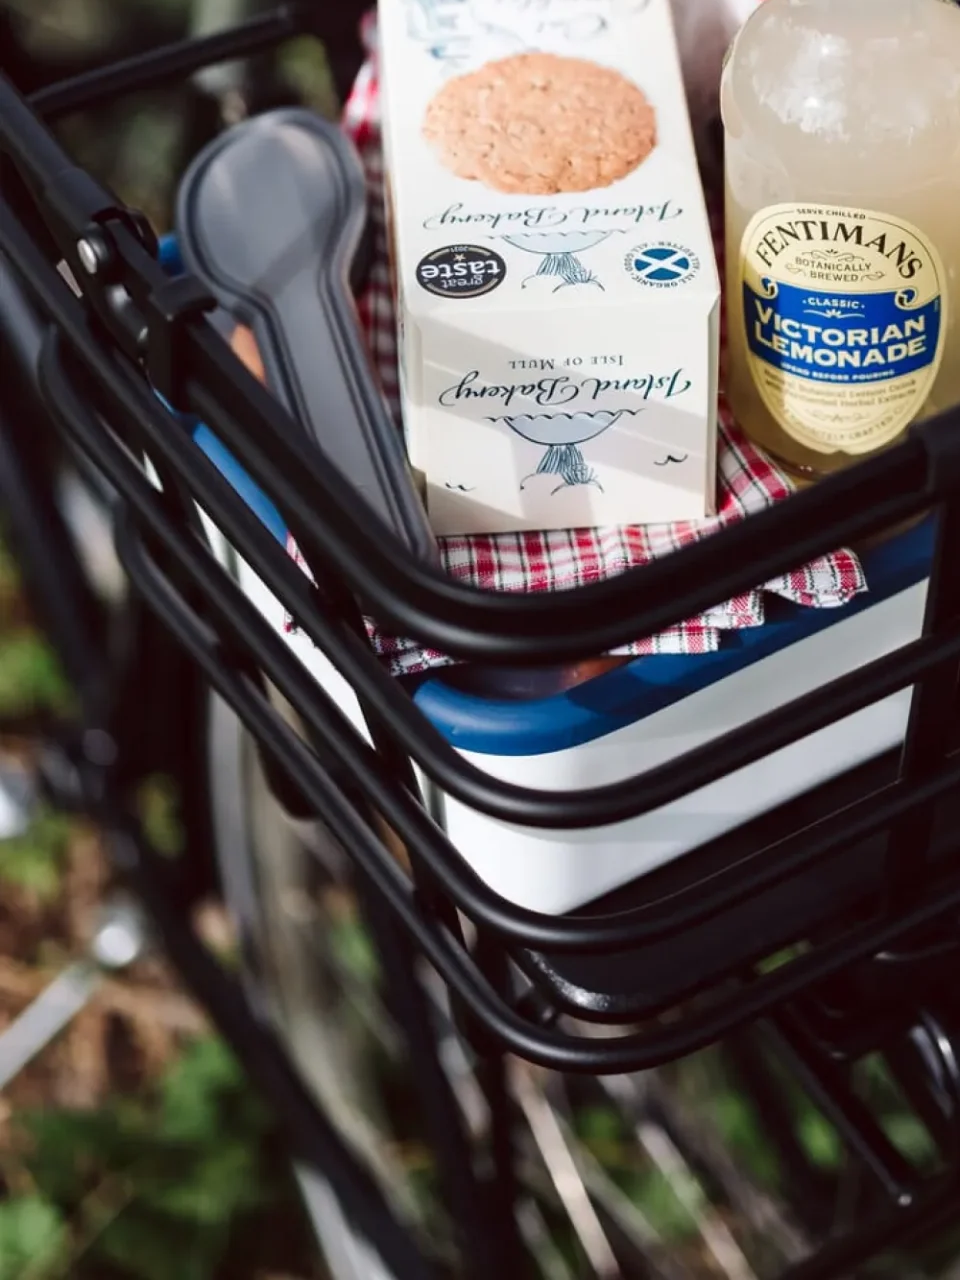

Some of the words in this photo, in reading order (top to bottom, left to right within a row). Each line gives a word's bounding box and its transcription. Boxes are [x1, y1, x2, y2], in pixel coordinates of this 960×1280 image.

[423, 202, 567, 230] Bakery
[570, 199, 684, 223] Island
[796, 208, 824, 216] SERVE
[826, 209, 866, 220] CHILLED
[755, 219, 923, 279] FENTIMANS
[421, 260, 501, 278] taste
[795, 256, 871, 272] BOTANICALLY
[441, 274, 484, 288] great
[631, 275, 678, 288] ORGANIC
[810, 271, 859, 282] BREWED
[808, 297, 860, 309] CLASSIC
[755, 298, 926, 347] VICTORIAN
[755, 321, 928, 368] LEMONADE
[508, 358, 555, 370] MULL
[563, 356, 583, 367] OF
[591, 354, 624, 366] ISLE
[438, 370, 579, 407] Bakery
[582, 368, 692, 400] Island
